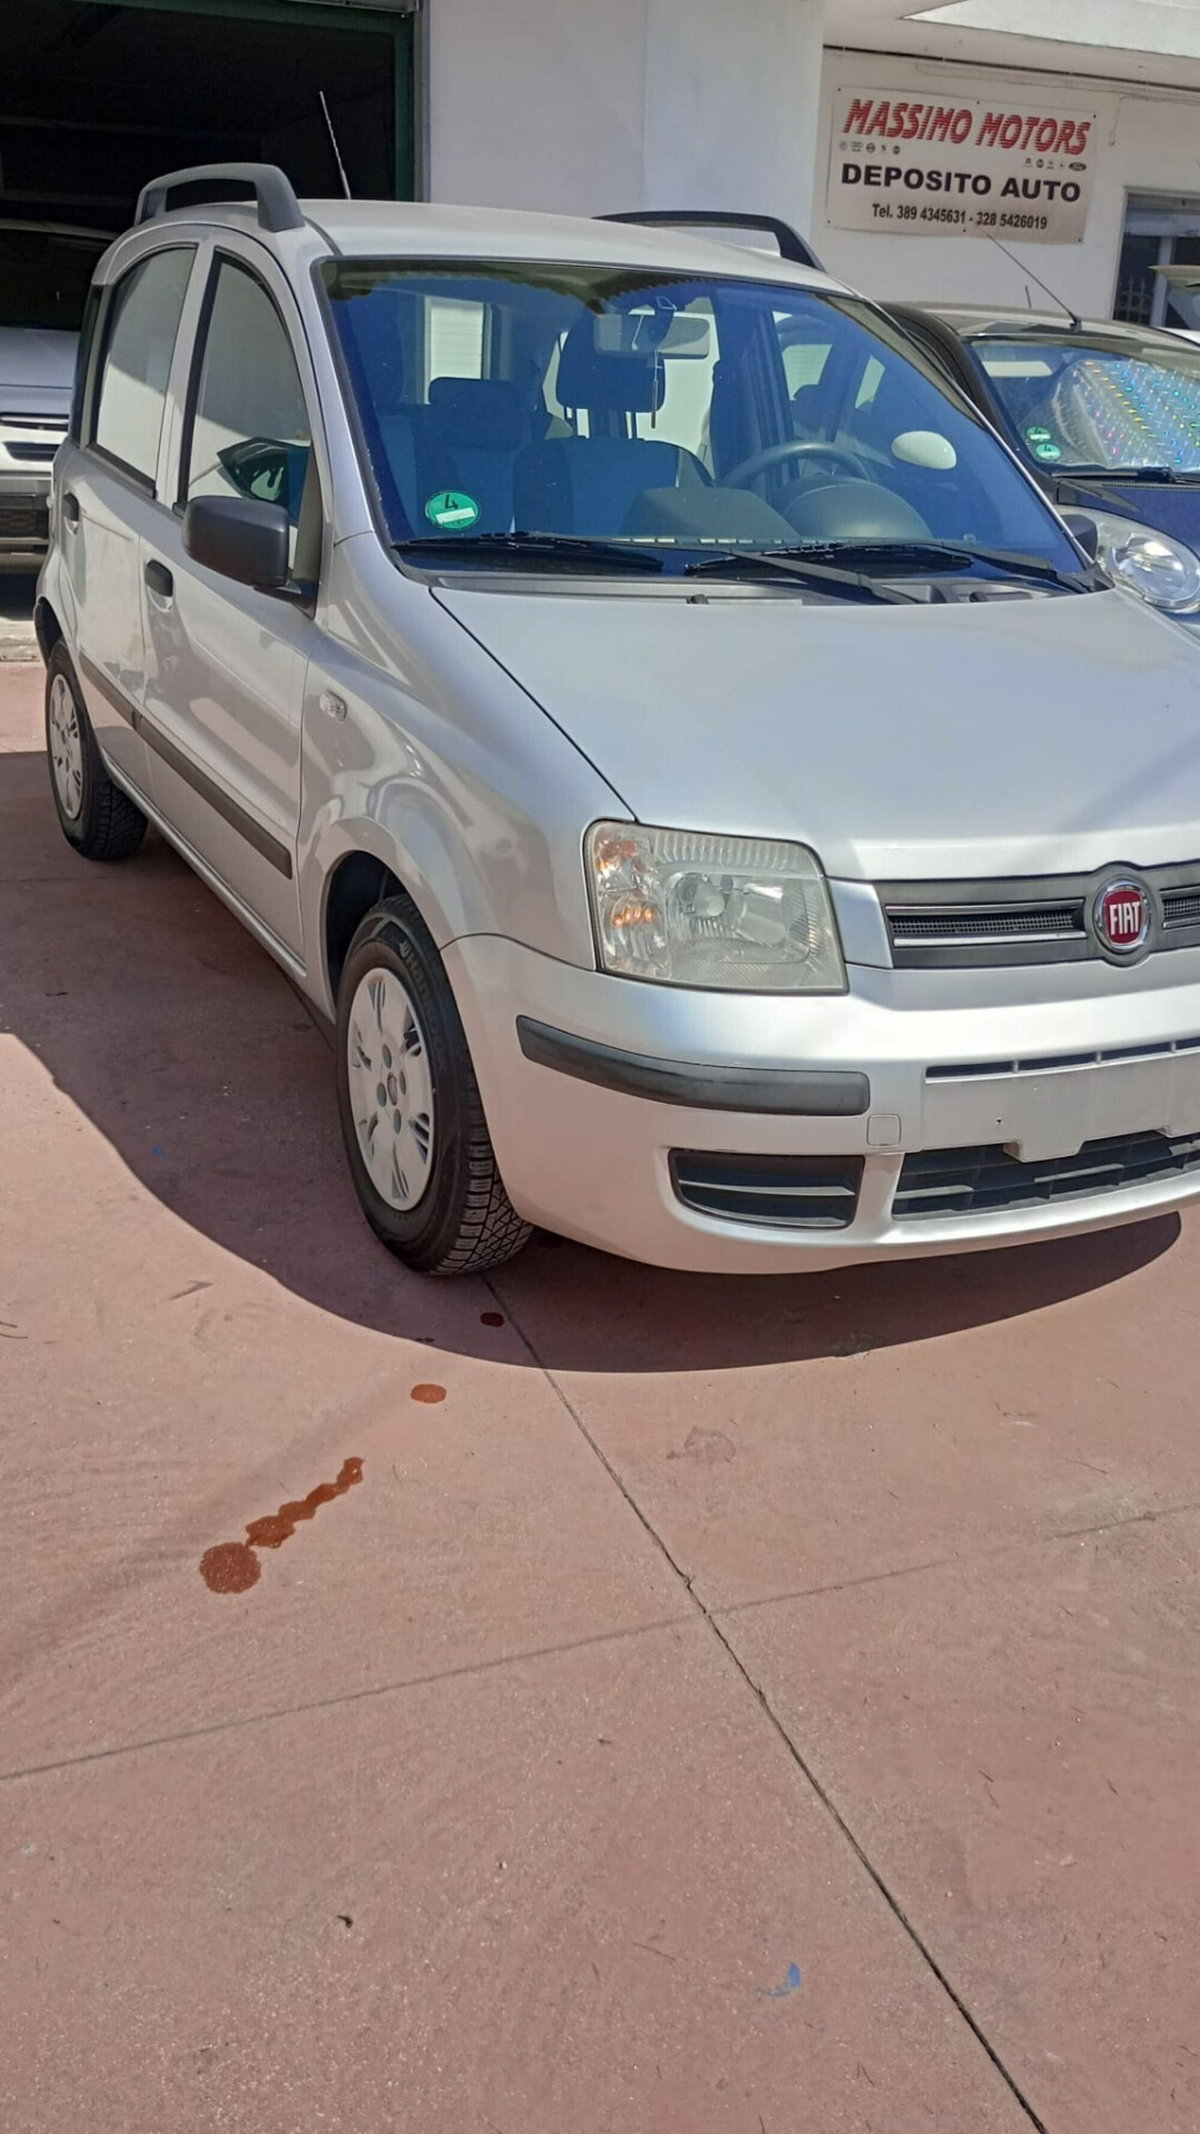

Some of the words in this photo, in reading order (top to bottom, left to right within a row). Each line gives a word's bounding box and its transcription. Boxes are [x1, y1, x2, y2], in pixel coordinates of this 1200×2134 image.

[842, 98, 973, 145] MASSIMO
[975, 112, 1092, 156] MOTORS
[841, 163, 992, 196] DEPOSITO
[1000, 177, 1081, 203] AUTO
[872, 203, 893, 219] Tel.
[897, 205, 917, 221] 389
[920, 206, 966, 225] 4345631
[976, 211, 997, 227] 328
[999, 213, 1048, 231] 5426019
[444, 494, 459, 510] 4
[1109, 901, 1141, 936] FIAT
